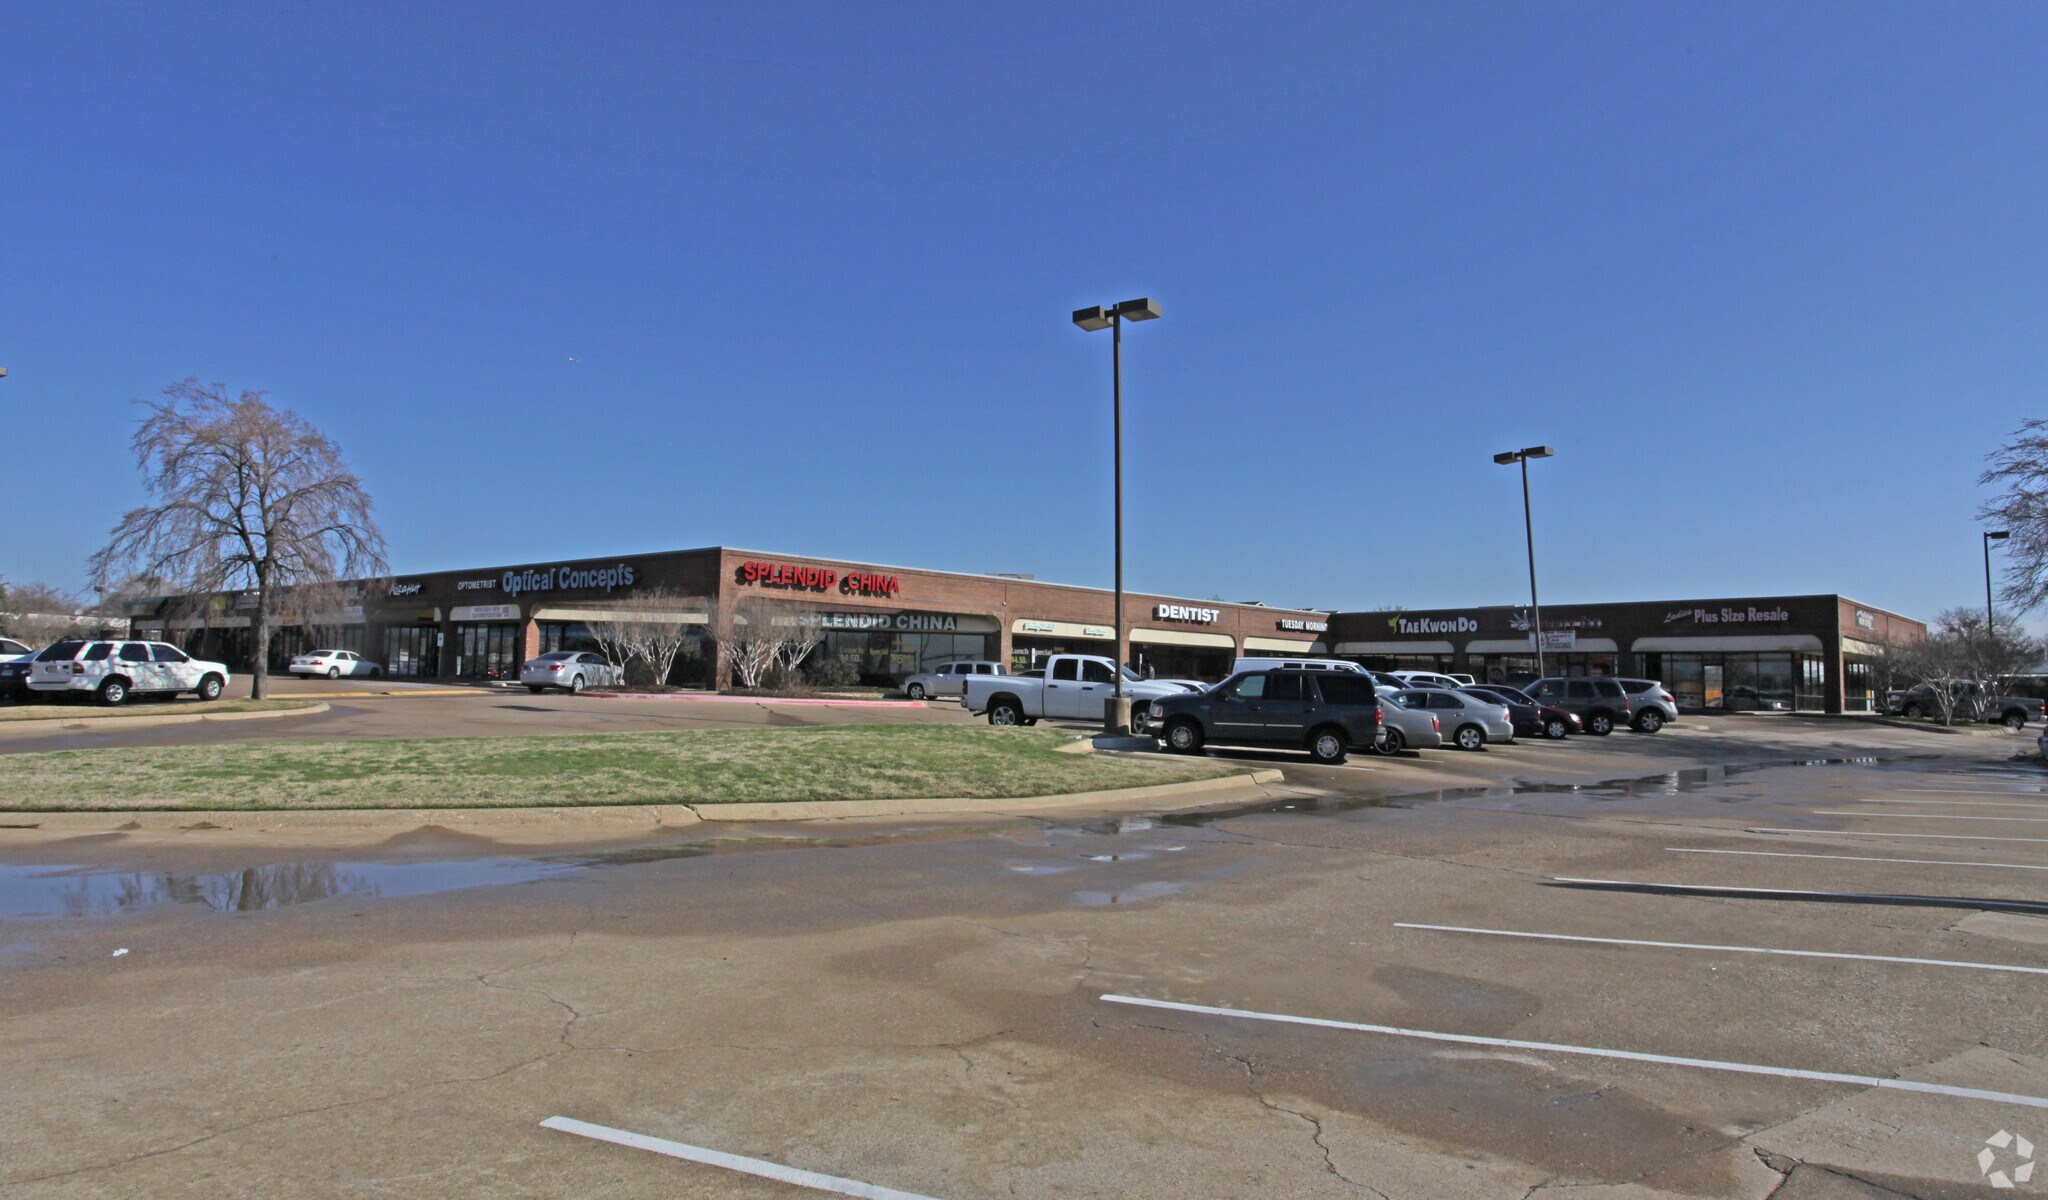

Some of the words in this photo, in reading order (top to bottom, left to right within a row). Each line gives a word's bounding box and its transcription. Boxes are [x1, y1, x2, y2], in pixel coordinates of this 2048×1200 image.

[457, 579, 497, 591] OPTOMETRIST
[502, 567, 556, 597] Optical
[559, 563, 634, 592] Concepts
[743, 561, 838, 588] SPLENDID
[847, 572, 900, 593] CHINA
[1159, 603, 1220, 622] DENTIST
[1694, 609, 1719, 623] Plus
[1721, 607, 1745, 623] Size
[1747, 606, 1789, 622] Resale
[896, 615, 956, 630] CHINA
[1281, 618, 1304, 630] TUESDAY
[1305, 621, 1328, 632] MORNING
[1033, 649, 1053, 657] pecial
